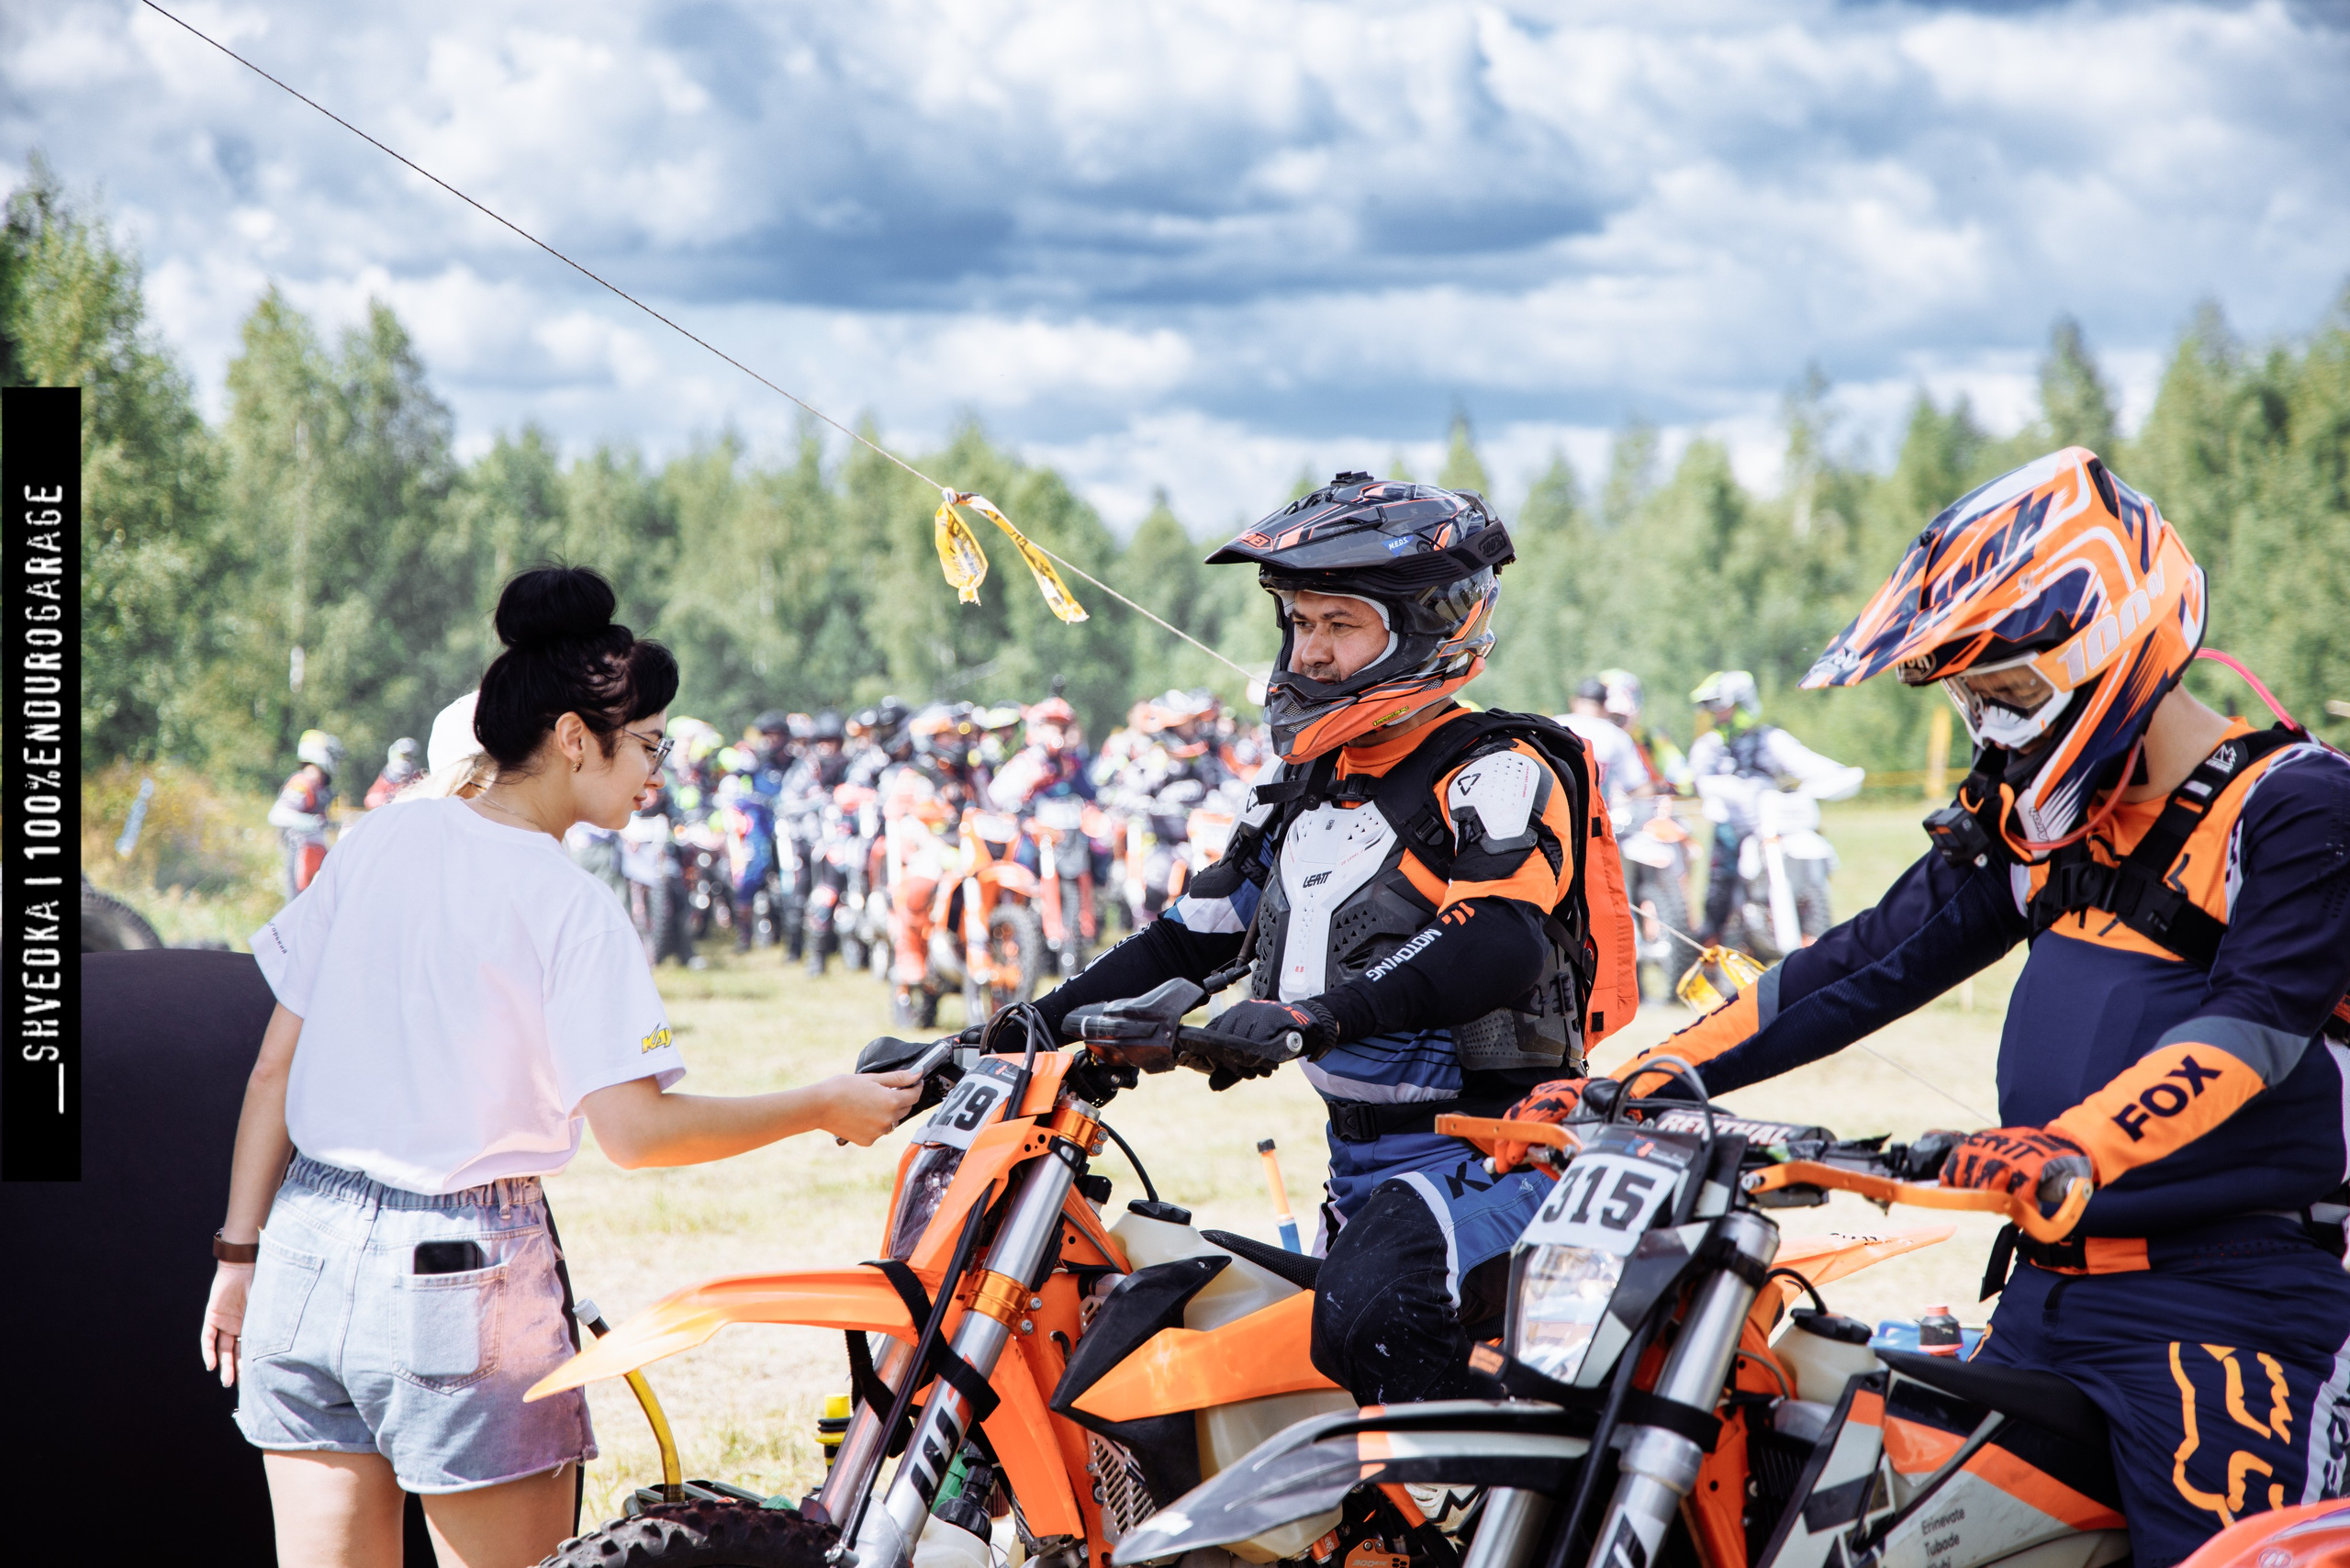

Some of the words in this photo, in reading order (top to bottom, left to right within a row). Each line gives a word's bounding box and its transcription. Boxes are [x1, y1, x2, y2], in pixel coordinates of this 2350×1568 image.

[1303, 871, 1333, 889] LEATT
[1365, 928, 1443, 982] MOTOKING
[2110, 1055, 2223, 1142] FOX
[1542, 1164, 1658, 1231] 315
[1921, 1507, 1966, 1536] Erinevate
[1924, 1532, 1961, 1558] Tubade
